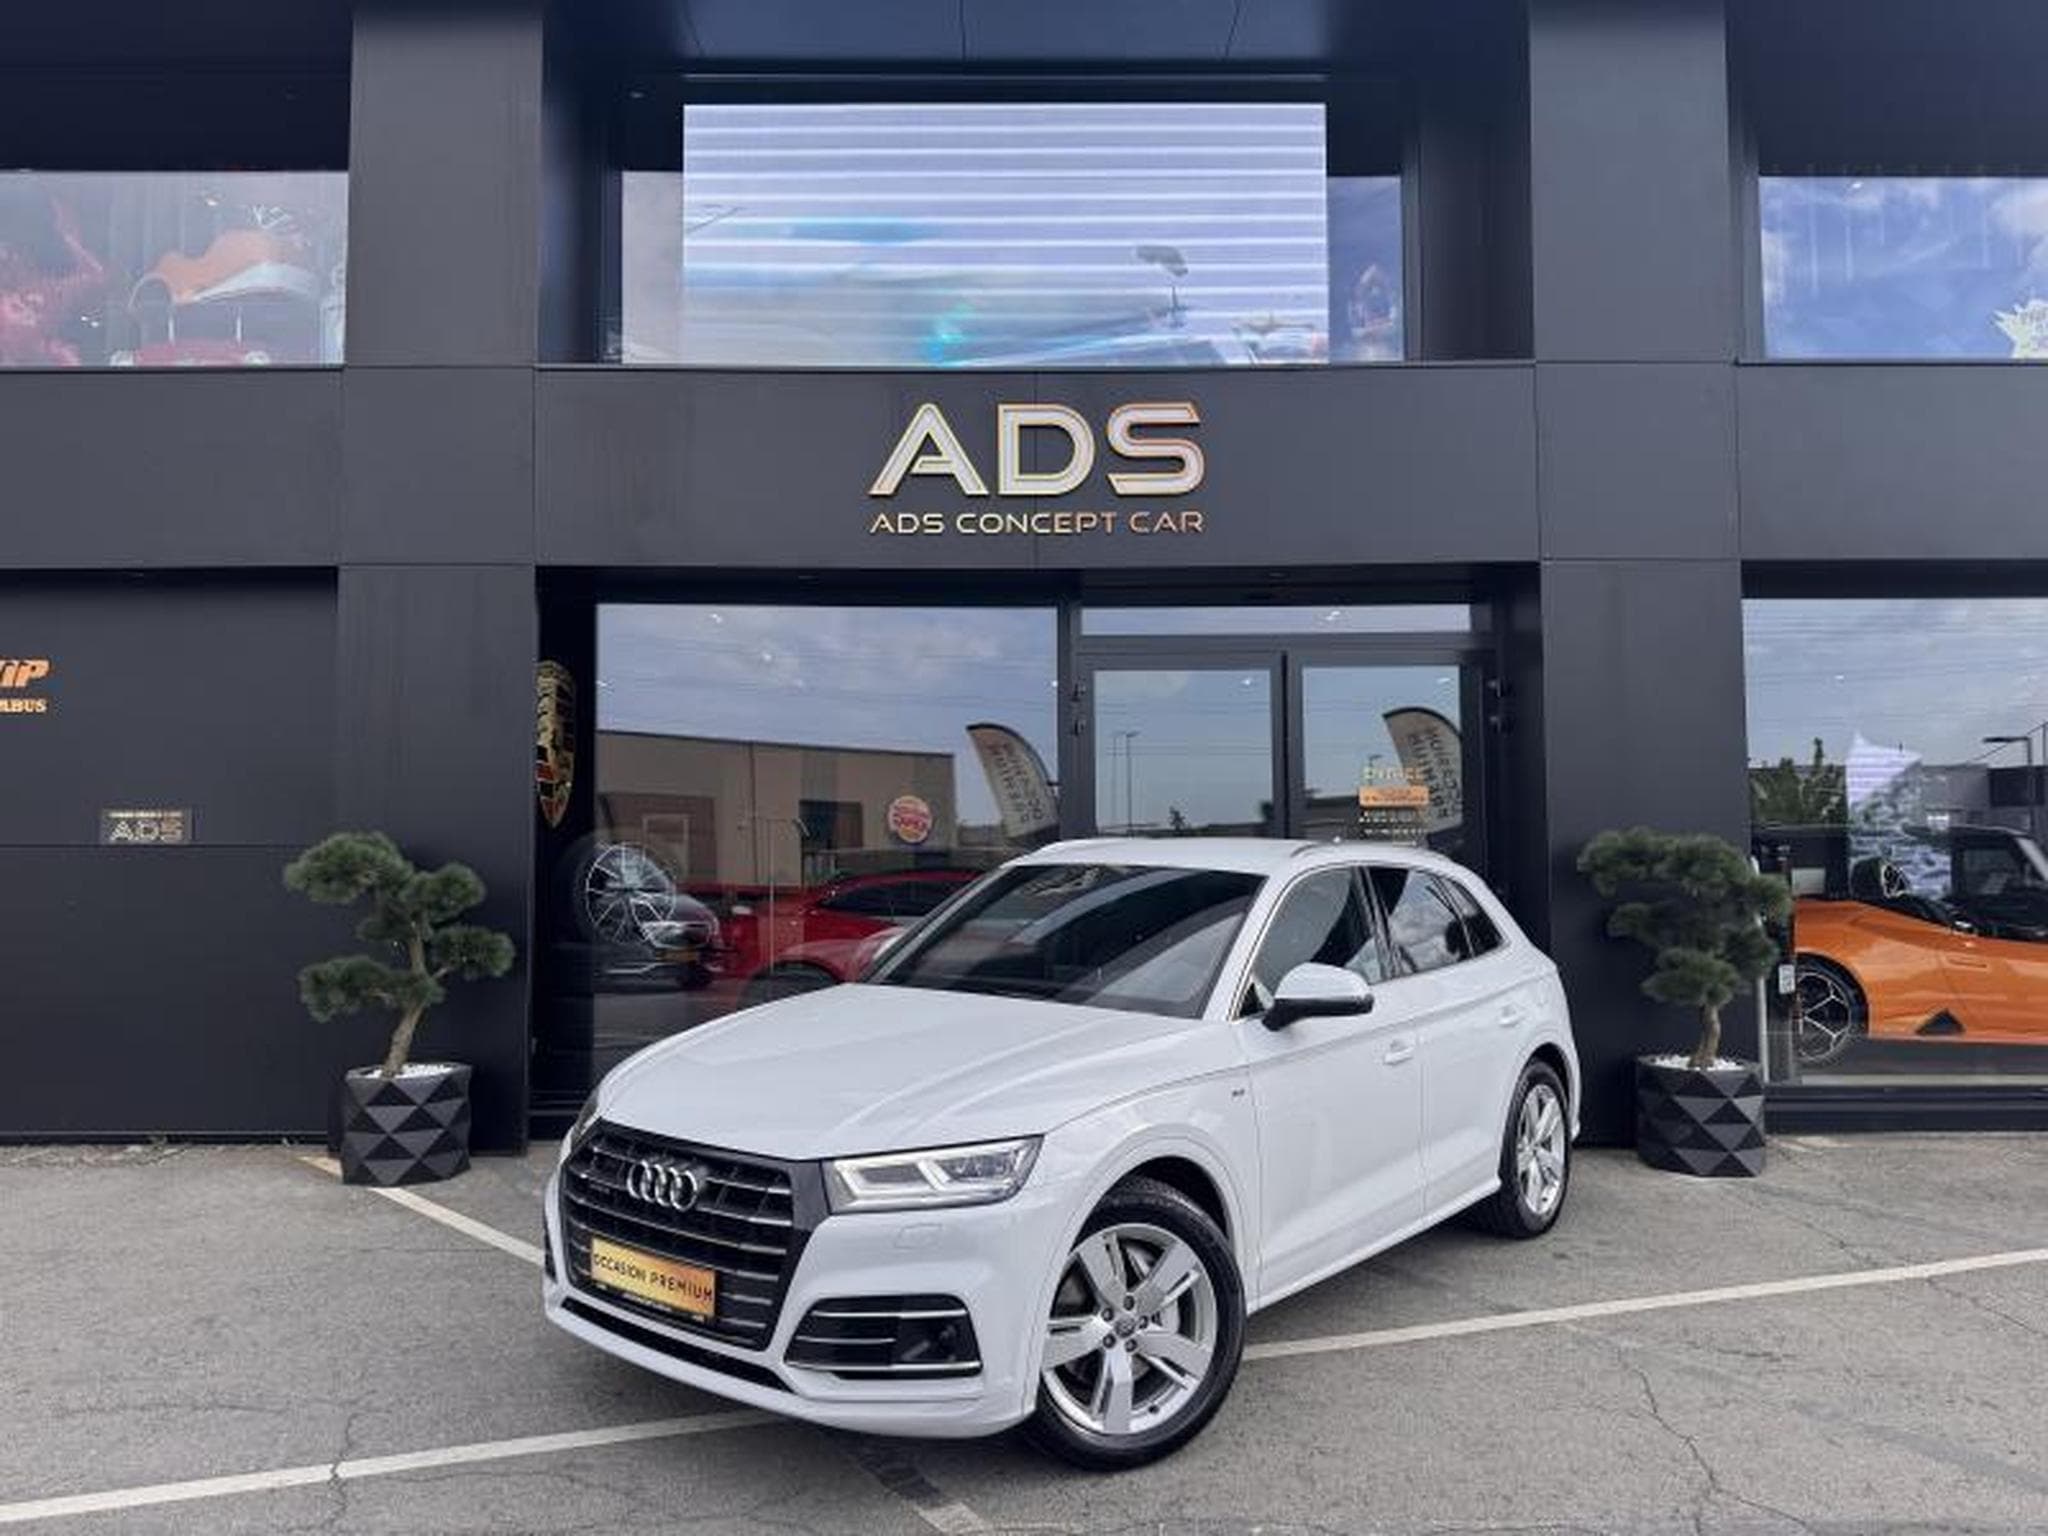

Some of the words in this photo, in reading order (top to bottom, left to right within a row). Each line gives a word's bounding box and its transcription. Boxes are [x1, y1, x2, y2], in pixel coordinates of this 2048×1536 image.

[869, 402, 1205, 496] ADS
[869, 512, 945, 534] ADS
[955, 511, 1117, 534] CONCEPT
[1129, 510, 1204, 533] CAR
[109, 820, 183, 842] ADS
[593, 1253, 645, 1282] OCCASION
[650, 1271, 712, 1301] PREMIUM
